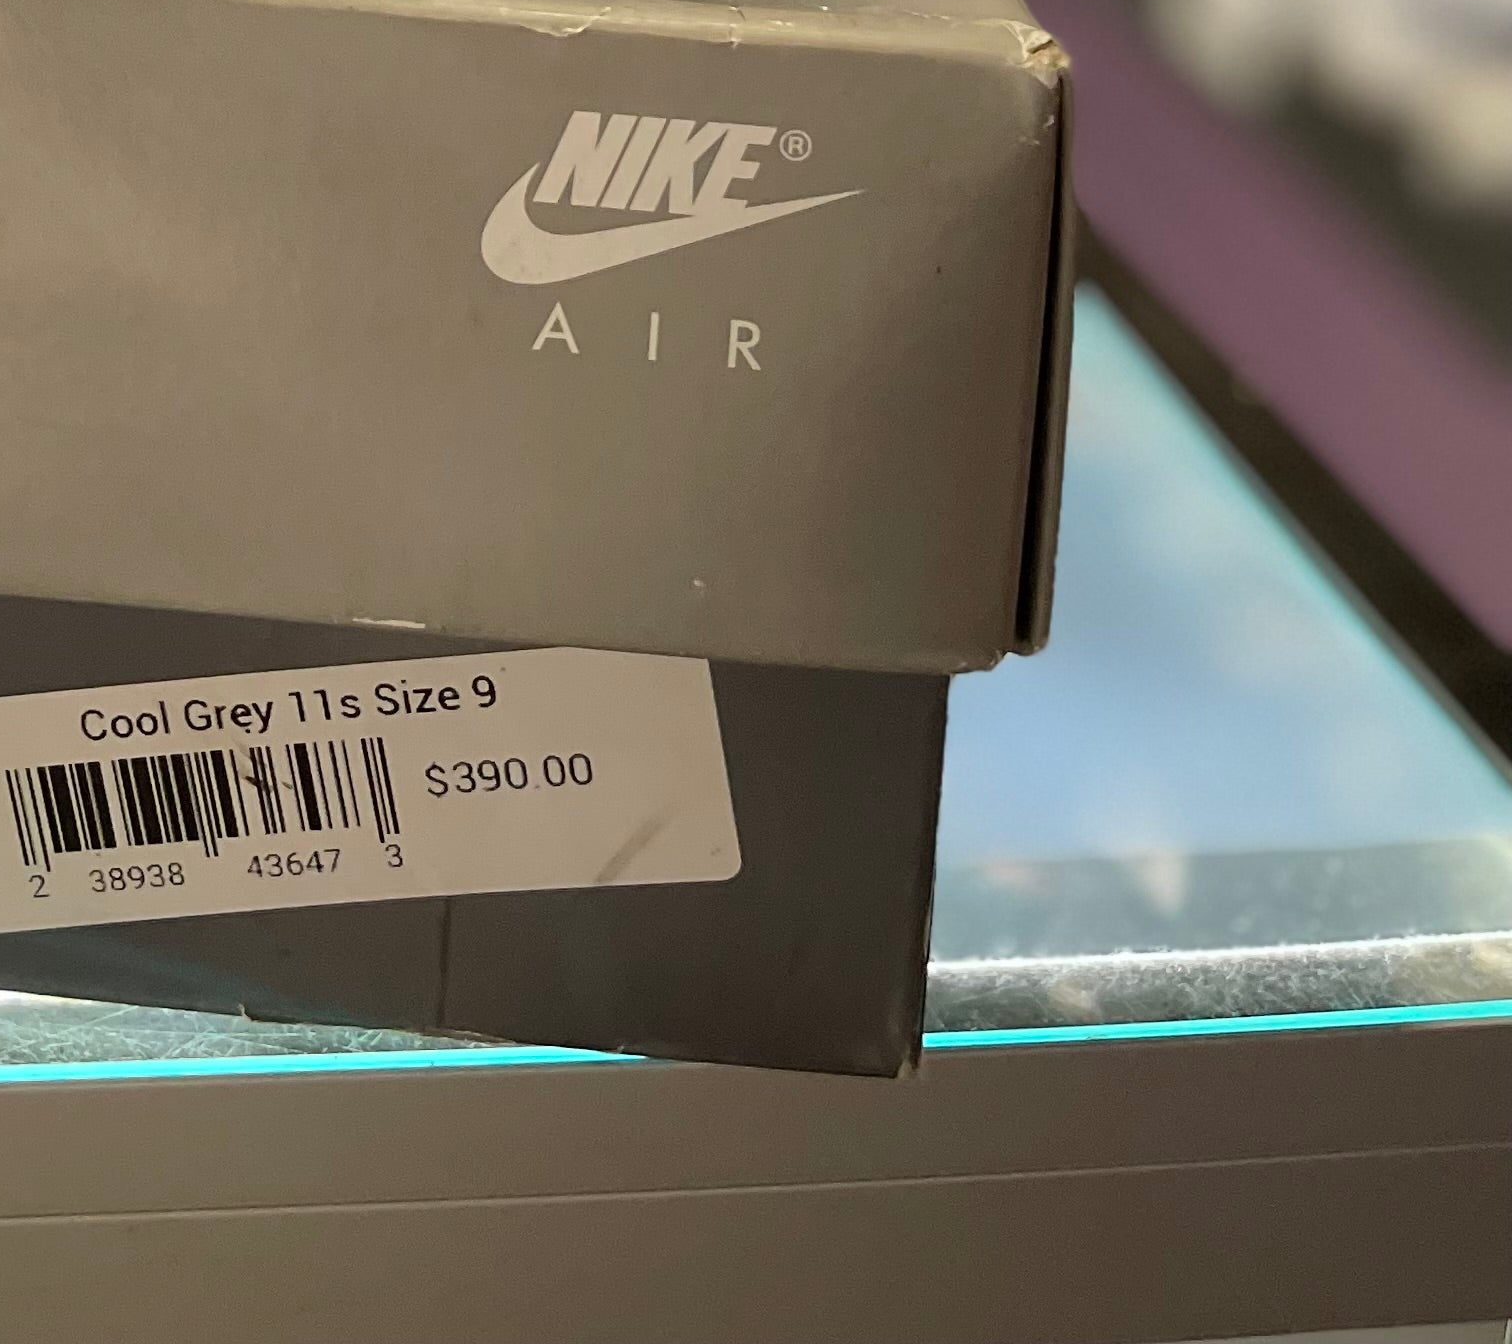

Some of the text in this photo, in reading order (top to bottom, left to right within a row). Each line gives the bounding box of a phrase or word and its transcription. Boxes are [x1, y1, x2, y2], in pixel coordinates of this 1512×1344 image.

[533, 110, 778, 216] NIKE
[532, 301, 762, 371] AIR
[79, 674, 499, 743] Cool Grey 11s Size 9
[424, 750, 596, 799] $390.00
[28, 844, 405, 899] 2 38938 43647 3
